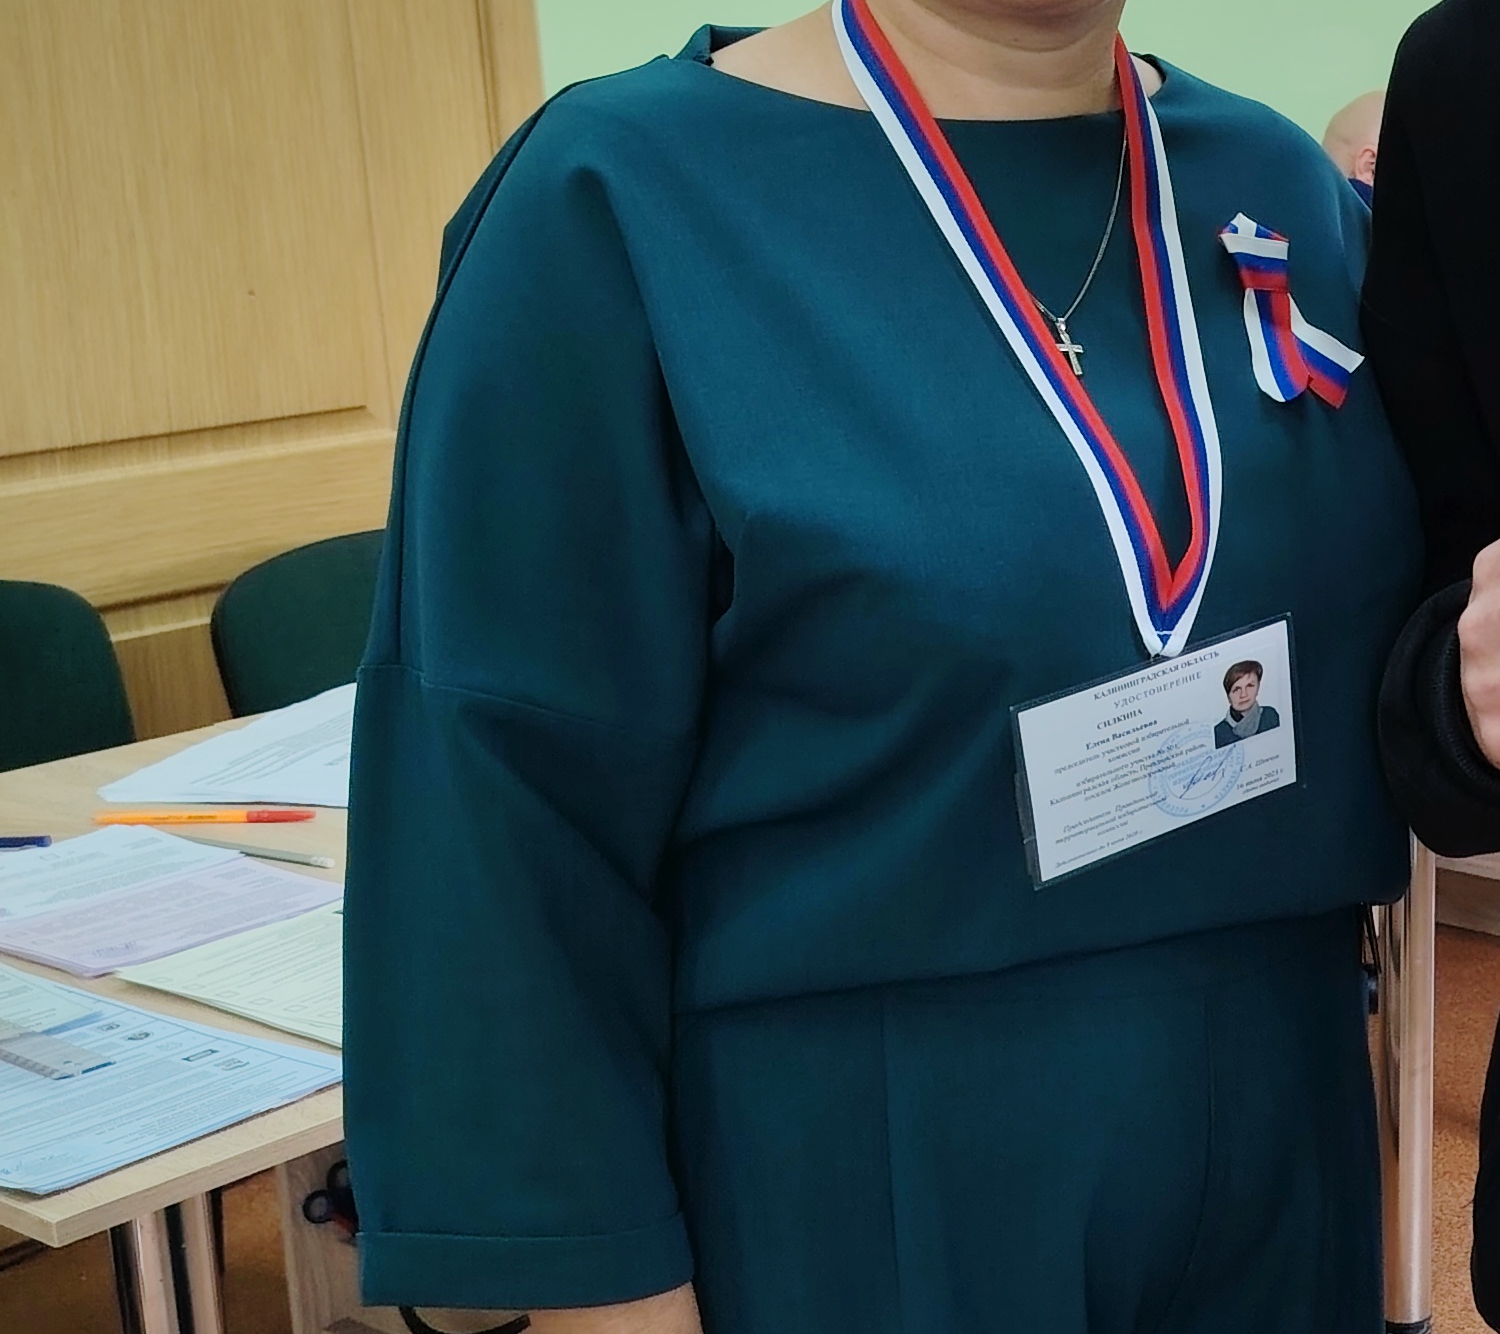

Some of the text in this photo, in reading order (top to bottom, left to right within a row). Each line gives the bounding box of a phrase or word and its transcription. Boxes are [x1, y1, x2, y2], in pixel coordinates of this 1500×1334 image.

[1094, 651, 1219, 701] КАЛИНИНГРАДСКАЯ ОБЛАСТЬ
[1114, 672, 1202, 710] УДОСТОВЕРЕНИЕ
